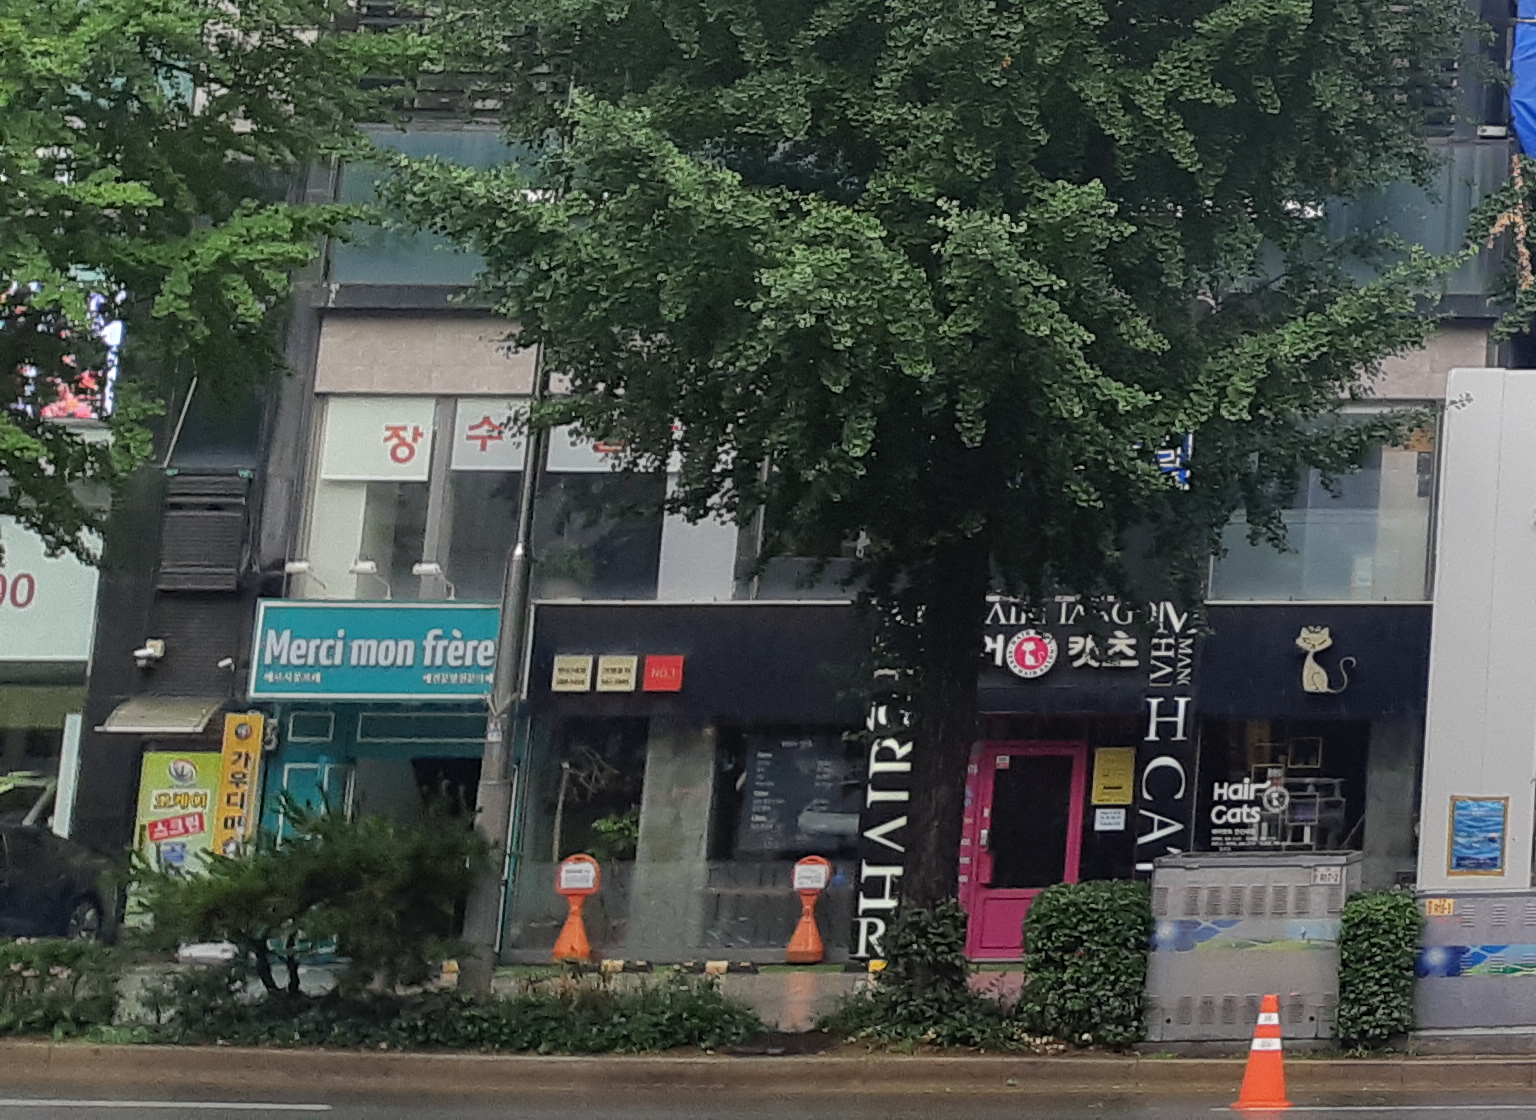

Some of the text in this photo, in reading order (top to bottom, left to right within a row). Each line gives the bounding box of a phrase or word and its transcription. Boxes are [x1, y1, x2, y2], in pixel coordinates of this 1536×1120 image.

[263, 628, 496, 667] Merci mon frère
[1213, 777, 1271, 801] Hair
[1210, 803, 1260, 825] Cats
